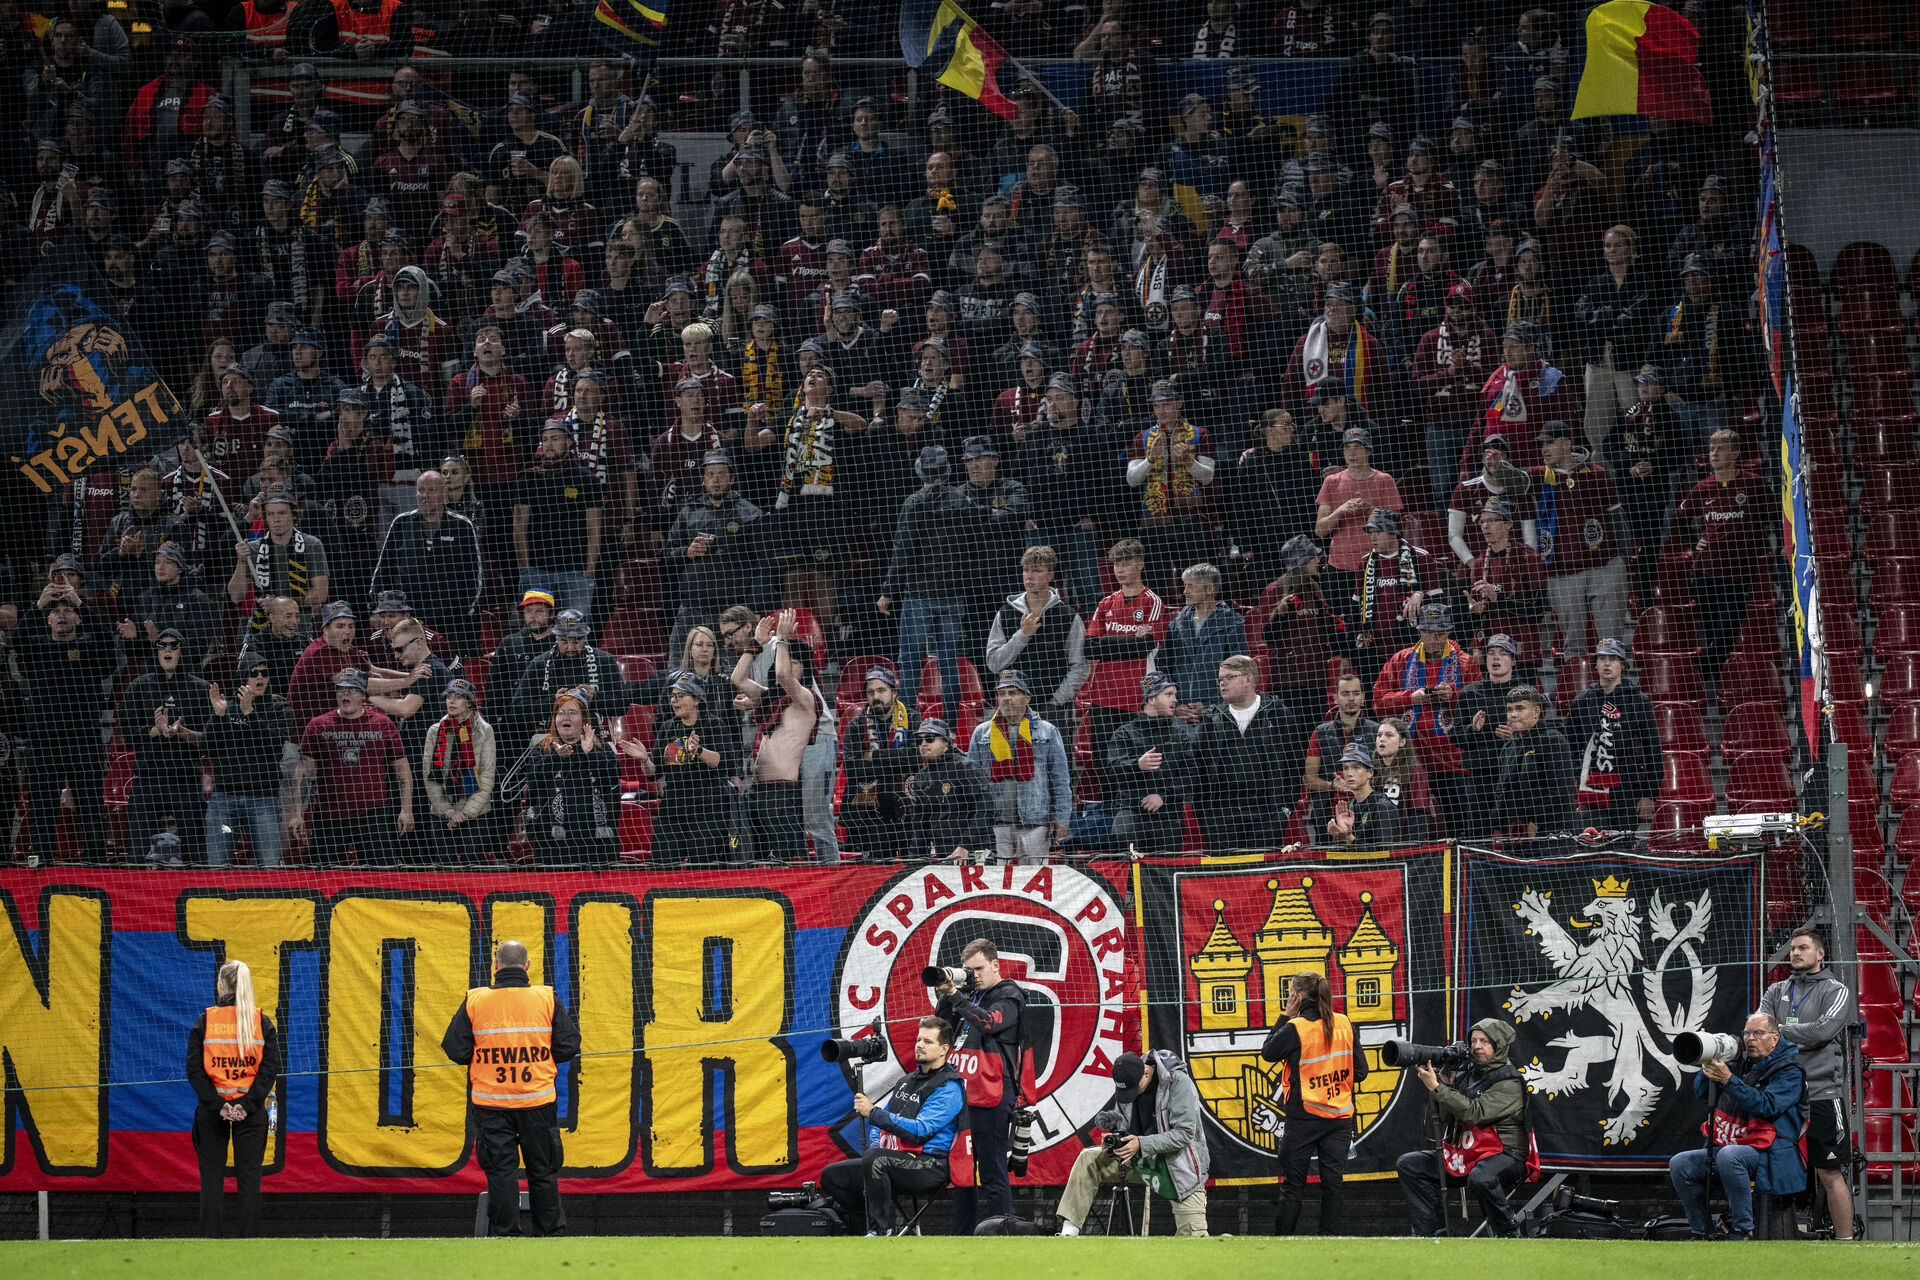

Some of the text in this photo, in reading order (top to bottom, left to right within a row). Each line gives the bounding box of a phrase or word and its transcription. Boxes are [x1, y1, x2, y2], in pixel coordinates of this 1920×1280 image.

[1111, 621, 1139, 634] Tipspo
[321, 731, 383, 741] SPARTA ARMY
[1074, 896, 1126, 1079] PRAHA
[176, 883, 799, 1178] TOUR
[474, 1047, 551, 1065] STEWARD
[225, 1069, 247, 1080] 156
[495, 1066, 532, 1084] 316
